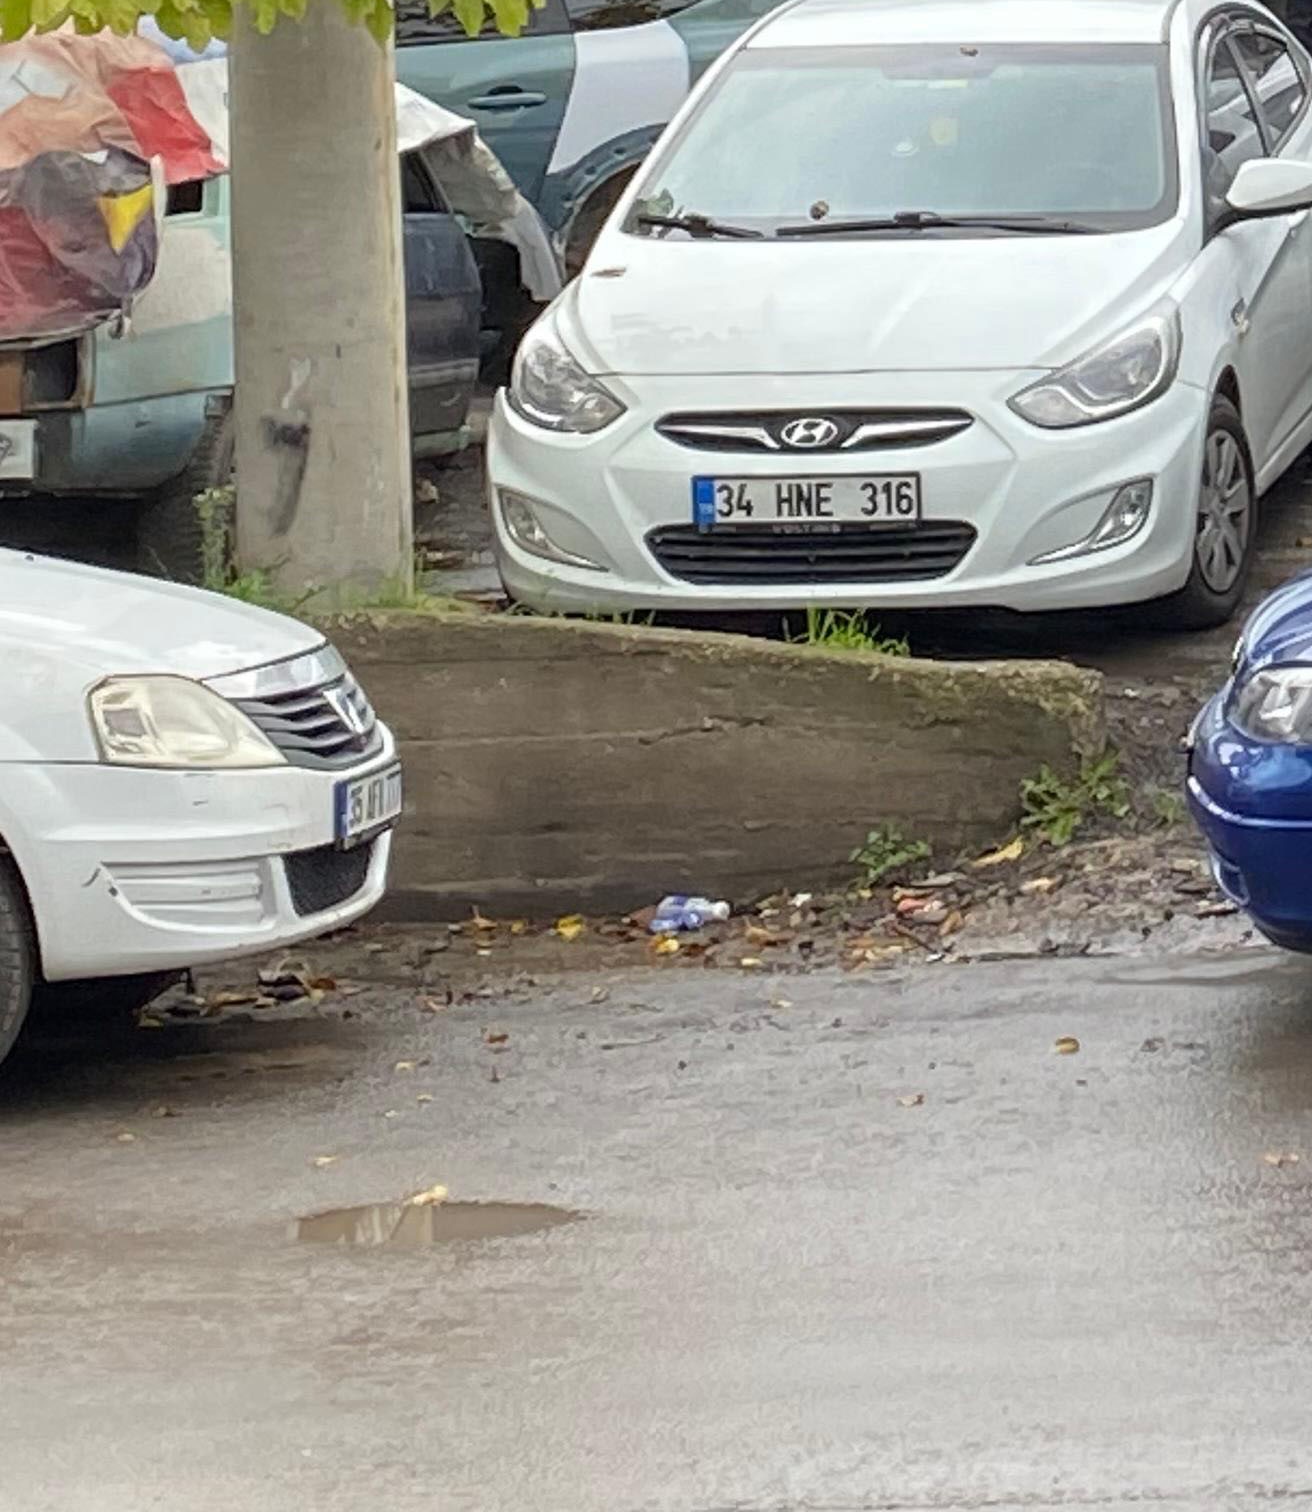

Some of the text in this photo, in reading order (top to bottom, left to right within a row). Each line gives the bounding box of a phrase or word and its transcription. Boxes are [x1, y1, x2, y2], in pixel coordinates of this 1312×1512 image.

[716, 483, 754, 518] 34
[775, 482, 835, 518] HNE
[860, 480, 914, 516] 316
